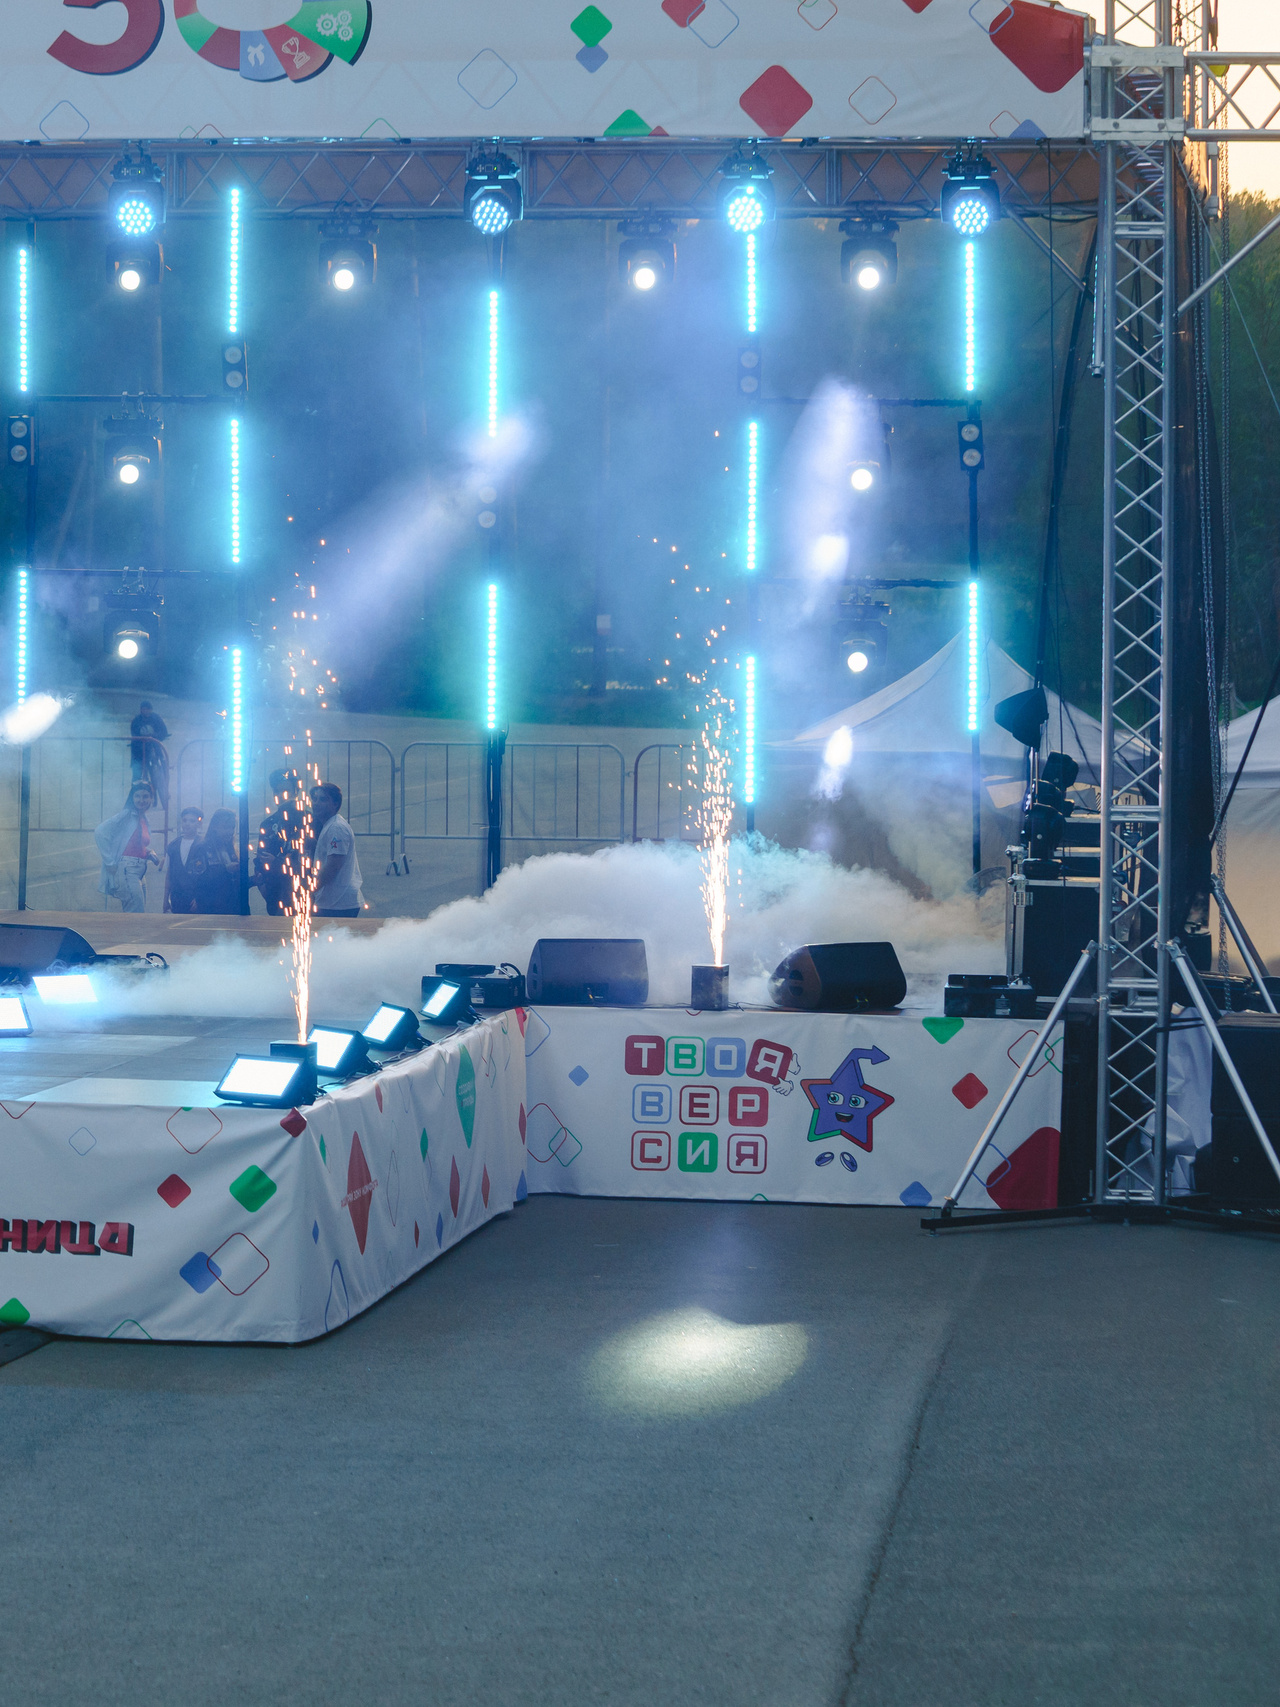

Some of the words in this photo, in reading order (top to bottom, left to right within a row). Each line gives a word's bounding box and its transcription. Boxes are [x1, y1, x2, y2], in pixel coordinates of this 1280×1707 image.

[633, 1042, 784, 1078] ТВОЯ
[640, 1091, 761, 1120] ВЕР
[639, 1137, 759, 1167] СИЯ
